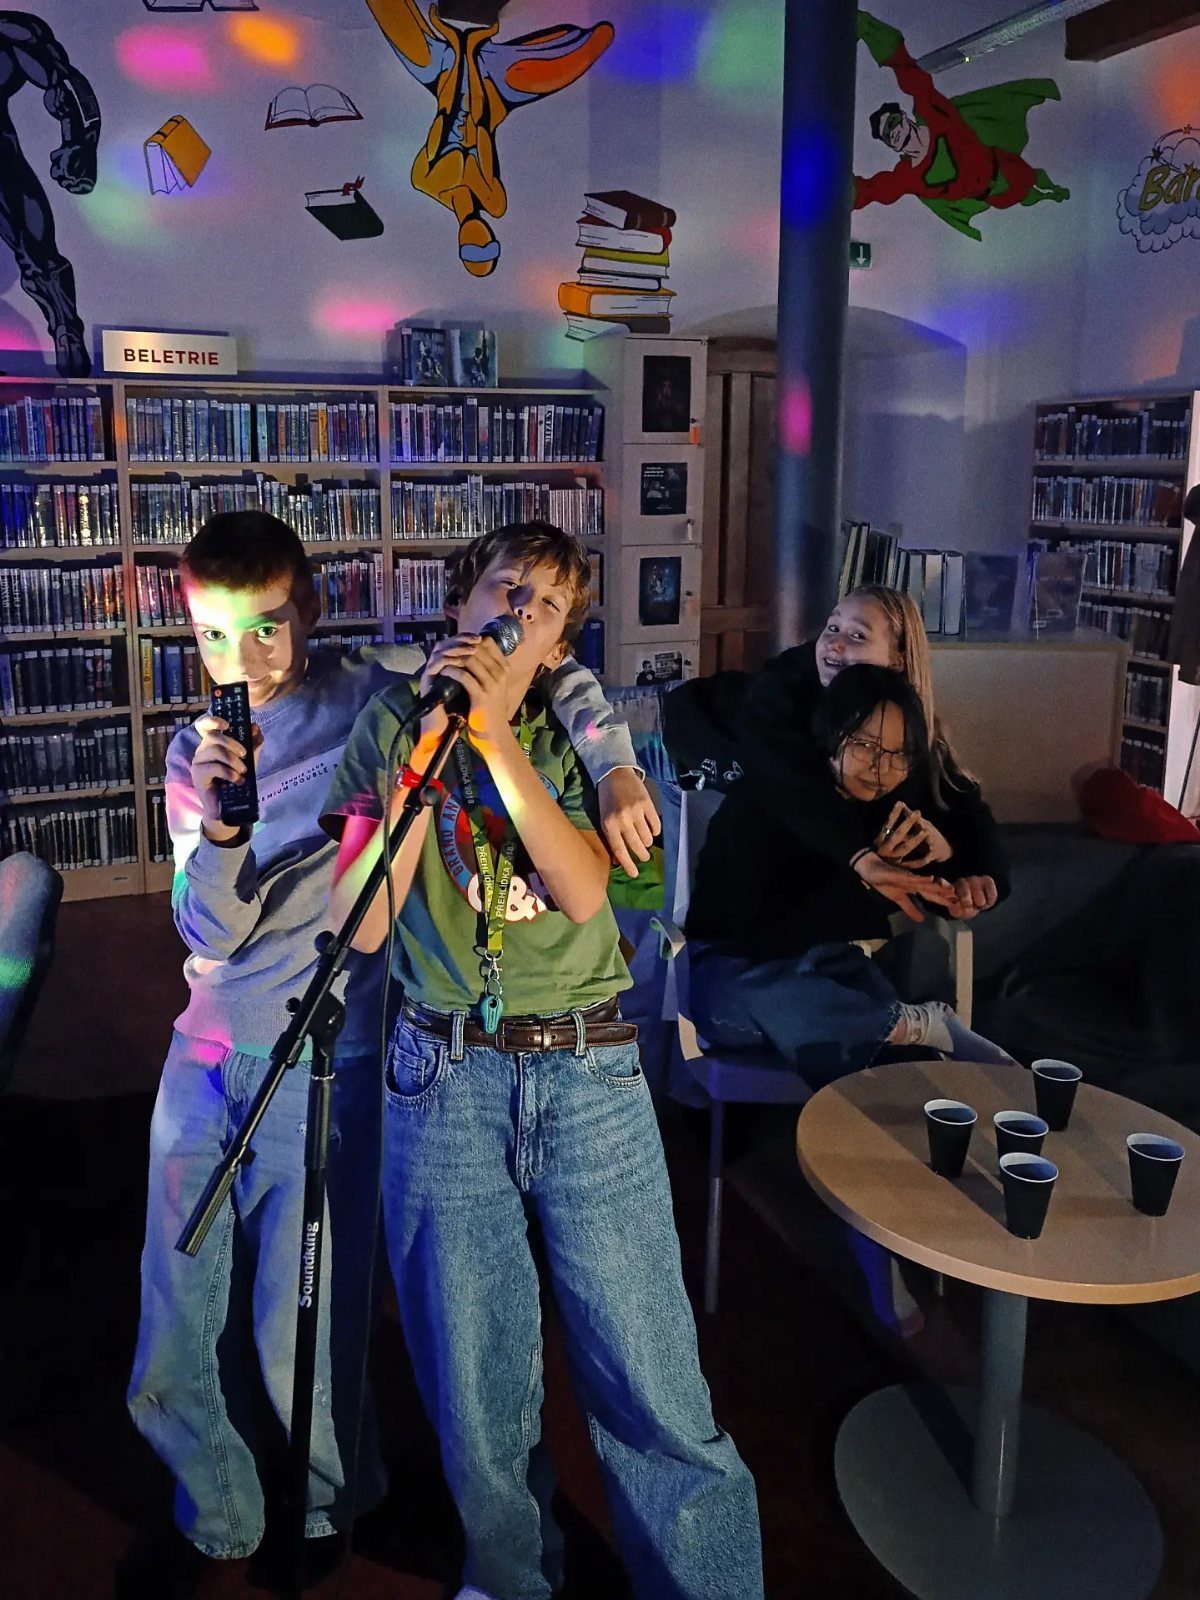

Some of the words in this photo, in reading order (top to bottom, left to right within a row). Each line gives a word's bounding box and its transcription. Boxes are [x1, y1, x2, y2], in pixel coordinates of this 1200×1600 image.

[123, 348, 219, 365] BELETRIE
[293, 767, 328, 787] DOUBLE
[465, 785, 475, 804] 2018
[299, 1221, 319, 1308] Soundking
